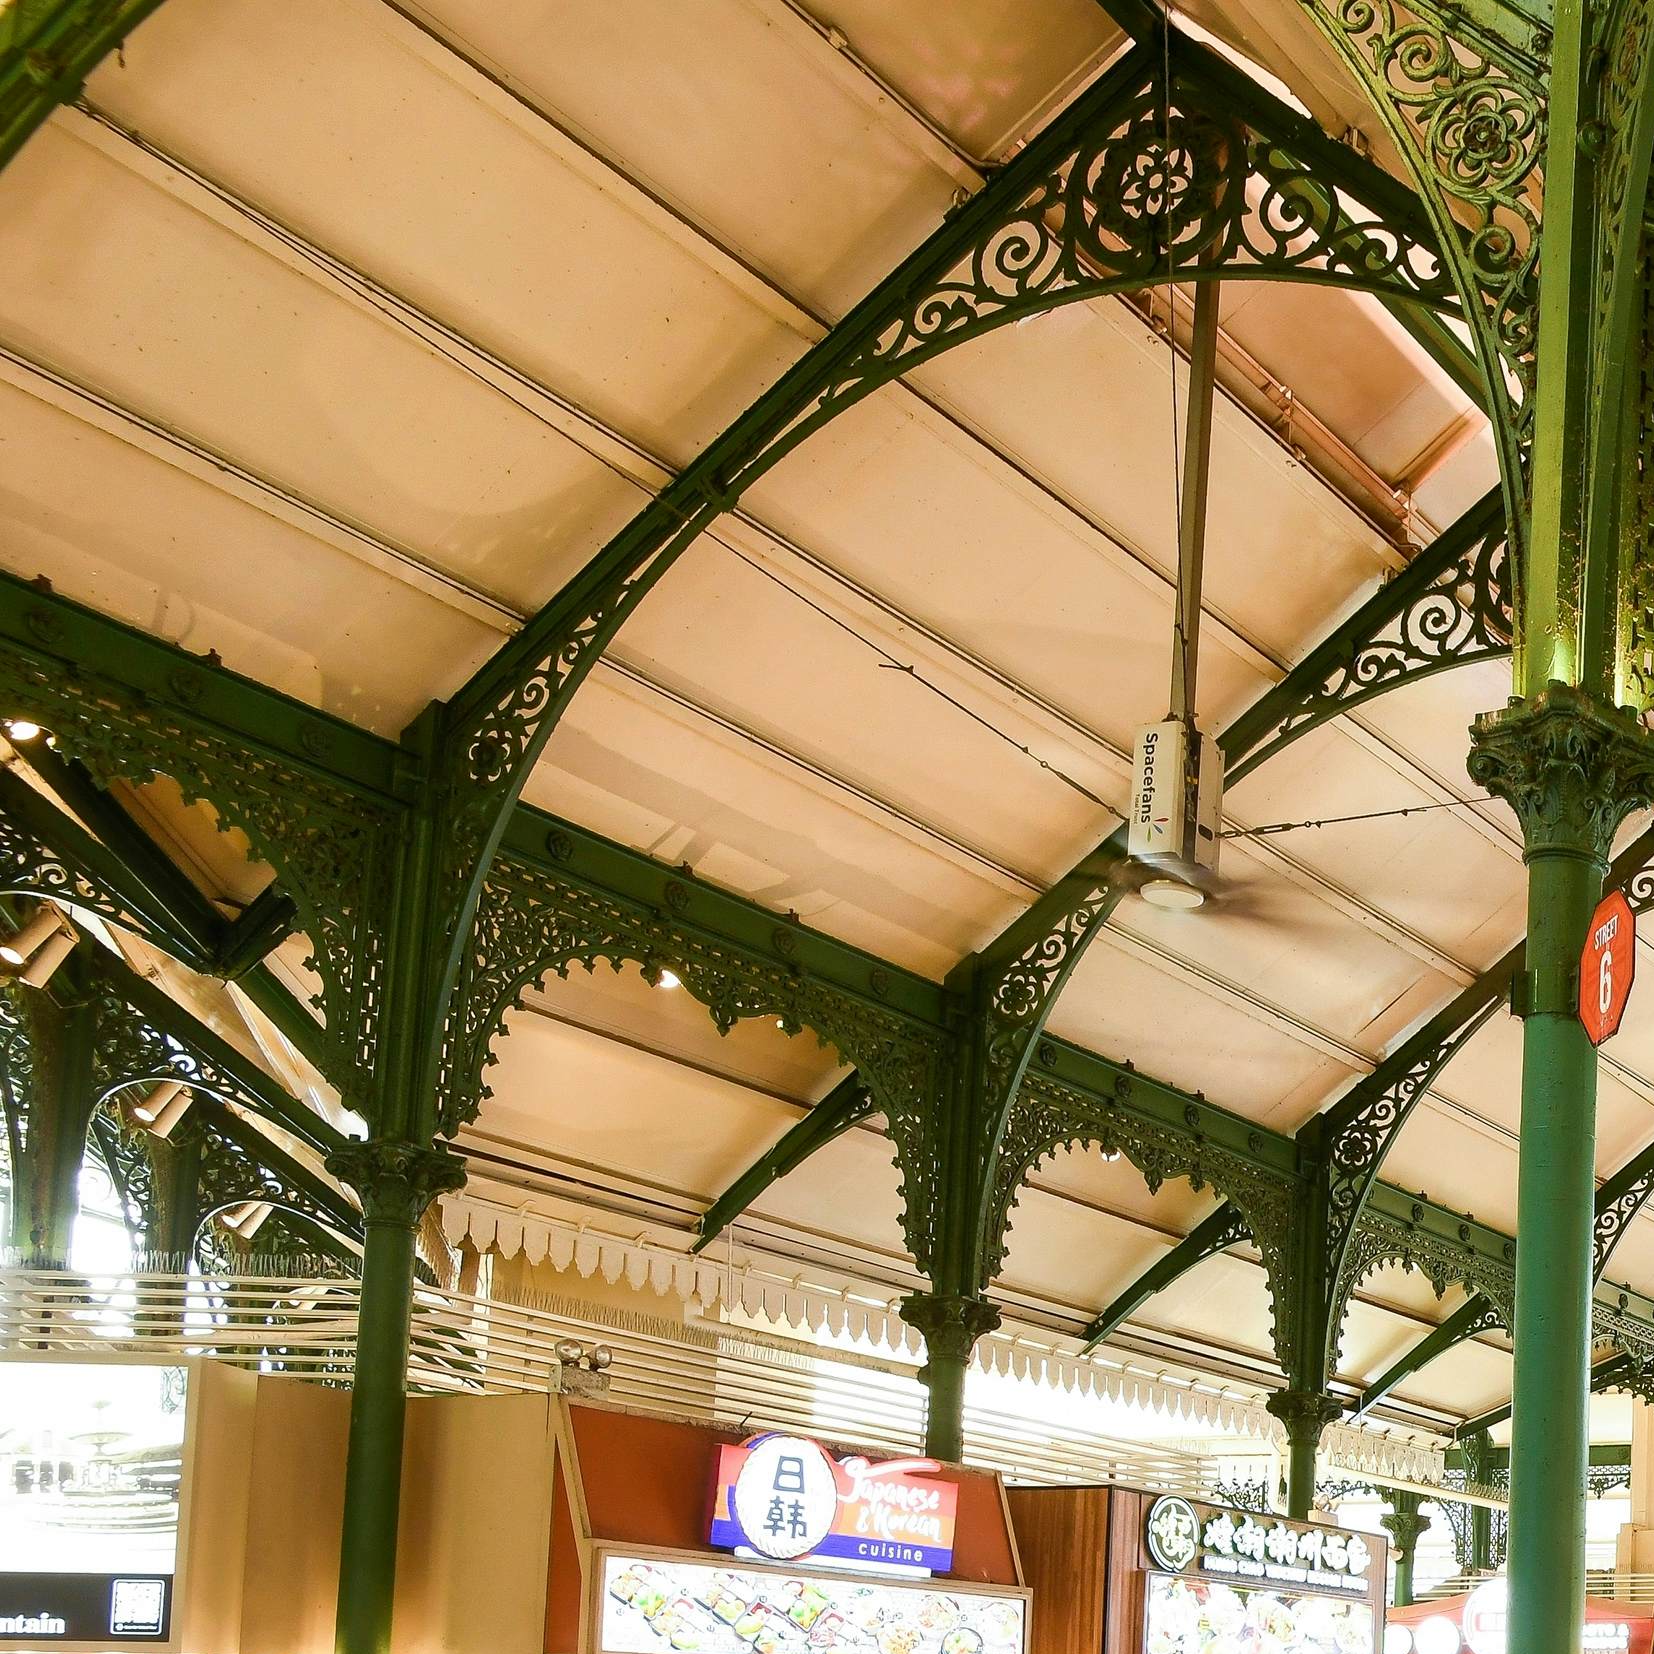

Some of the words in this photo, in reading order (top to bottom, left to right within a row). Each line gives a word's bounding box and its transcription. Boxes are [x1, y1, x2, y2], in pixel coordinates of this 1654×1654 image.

[1141, 732, 1159, 824] Spacefans
[1594, 914, 1618, 950] STREET
[1598, 950, 1613, 1014] 6
[763, 1455, 807, 1539] 日韩
[836, 1457, 941, 1515] Japanese
[874, 1501, 942, 1543] Korean
[858, 1543, 924, 1562] cuisine
